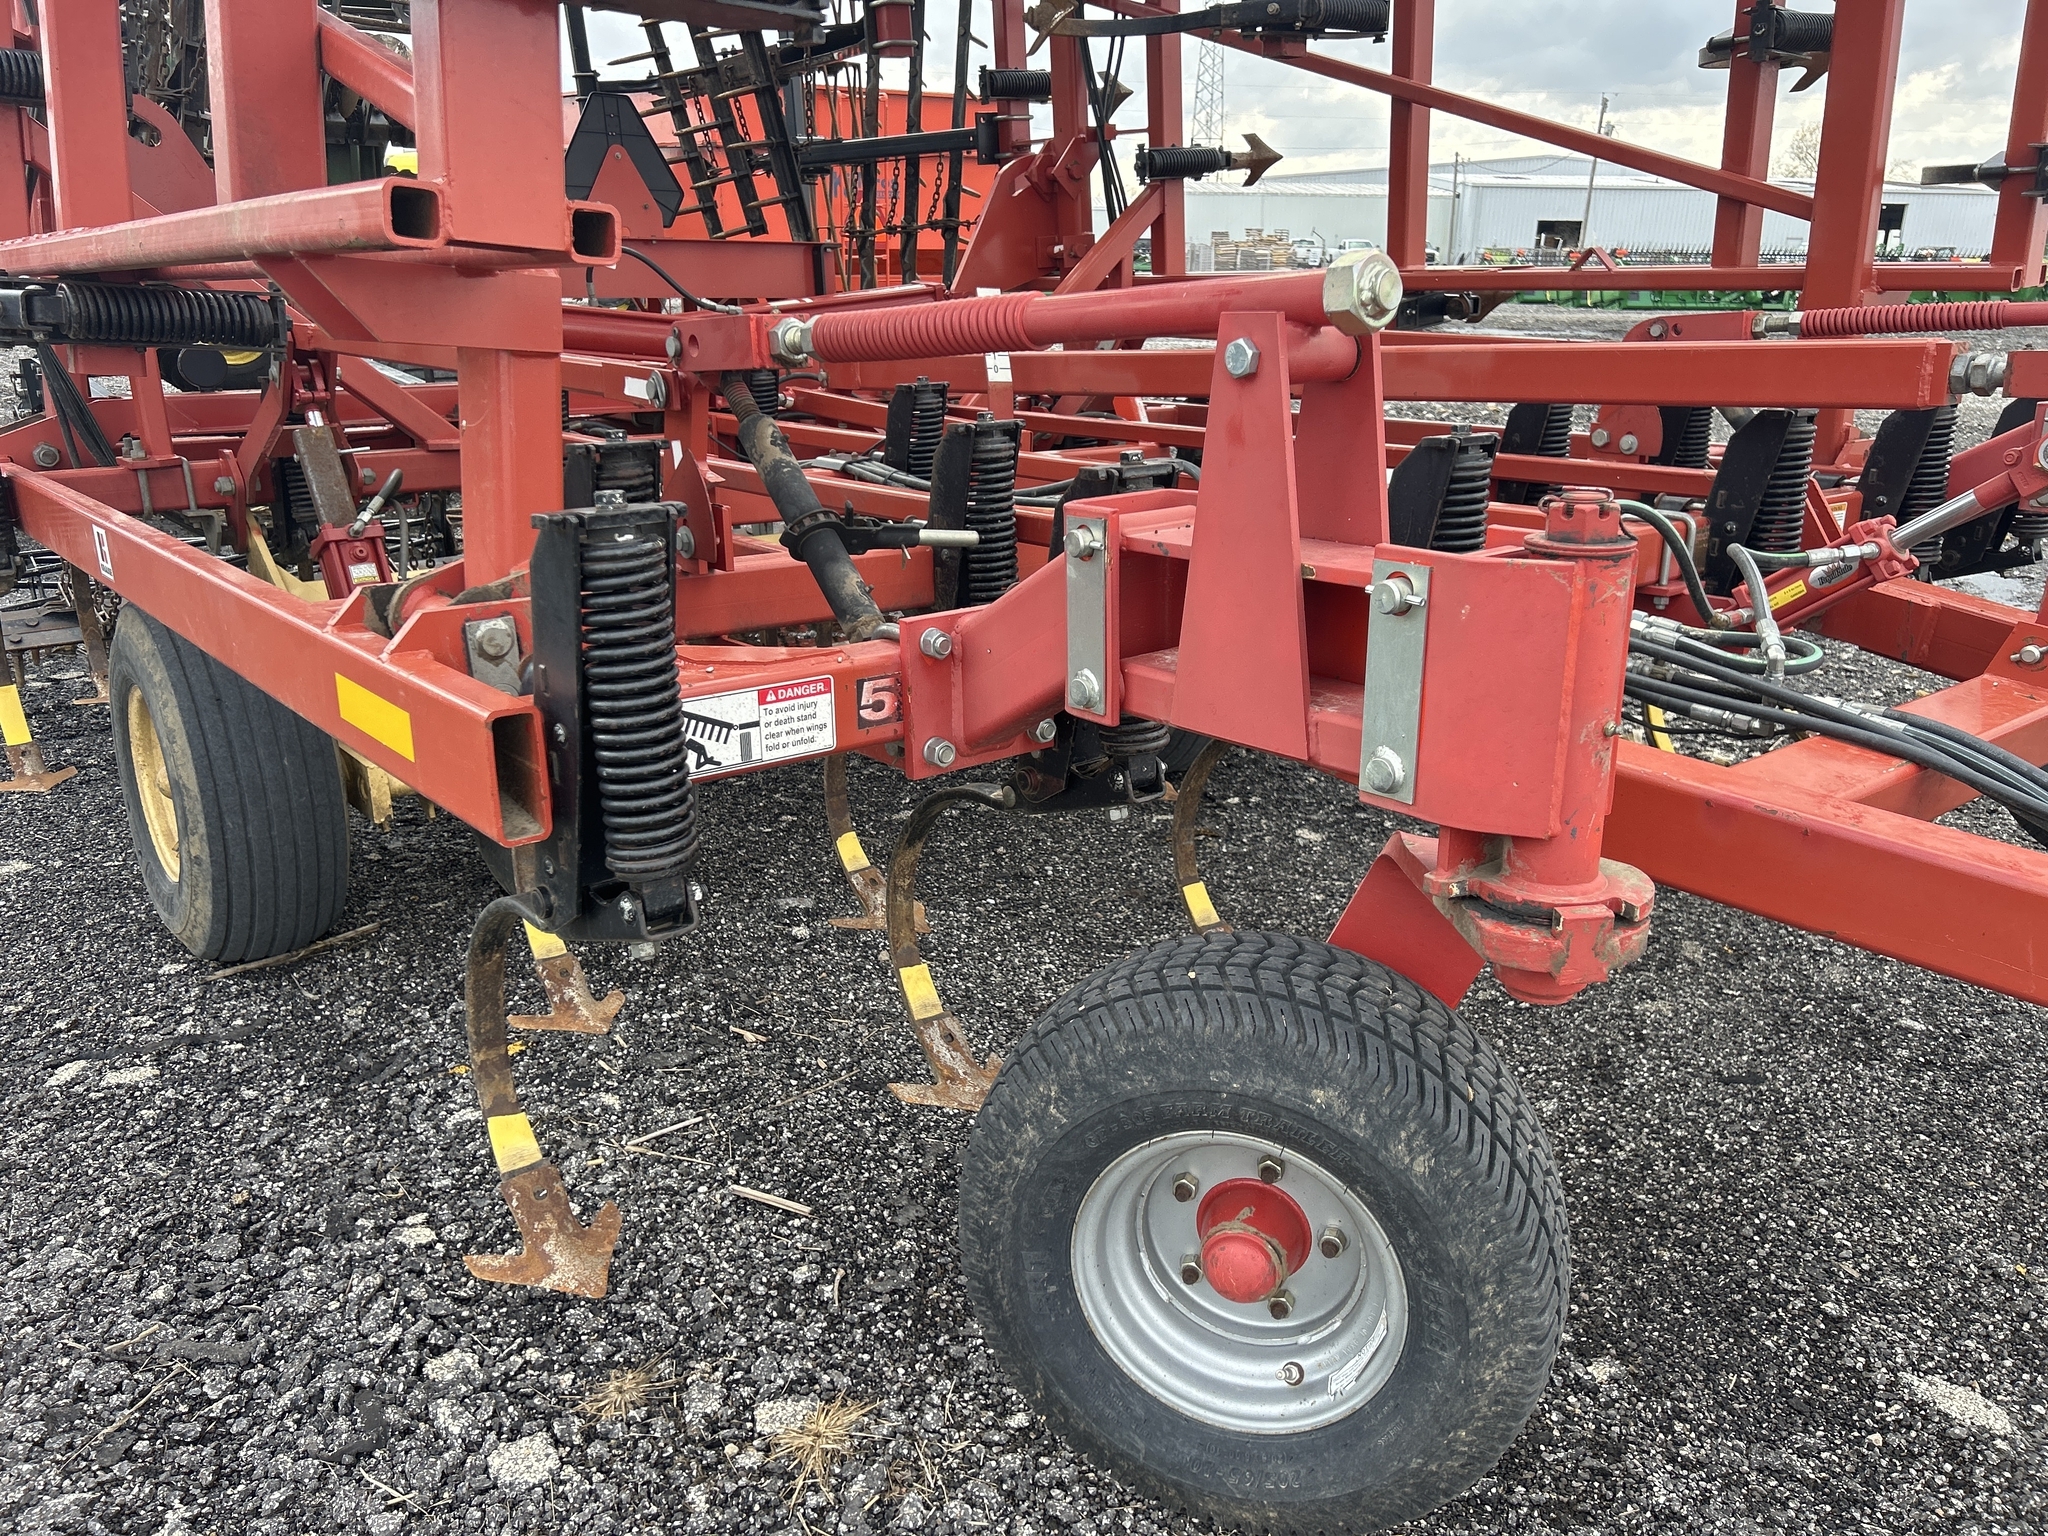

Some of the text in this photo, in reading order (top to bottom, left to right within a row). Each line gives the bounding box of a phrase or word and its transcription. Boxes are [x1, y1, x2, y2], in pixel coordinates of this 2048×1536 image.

[778, 683, 825, 699] DANGER
[859, 677, 897, 721] 5
[763, 700, 818, 717] To avoid injury
[773, 716, 795, 727] death
[796, 712, 817, 723] stand
[764, 722, 828, 740] clear when wings
[765, 735, 818, 752] fold or unfold.
[1159, 1103, 1233, 1119] FARM
[1240, 1107, 1352, 1164] TRAILER
